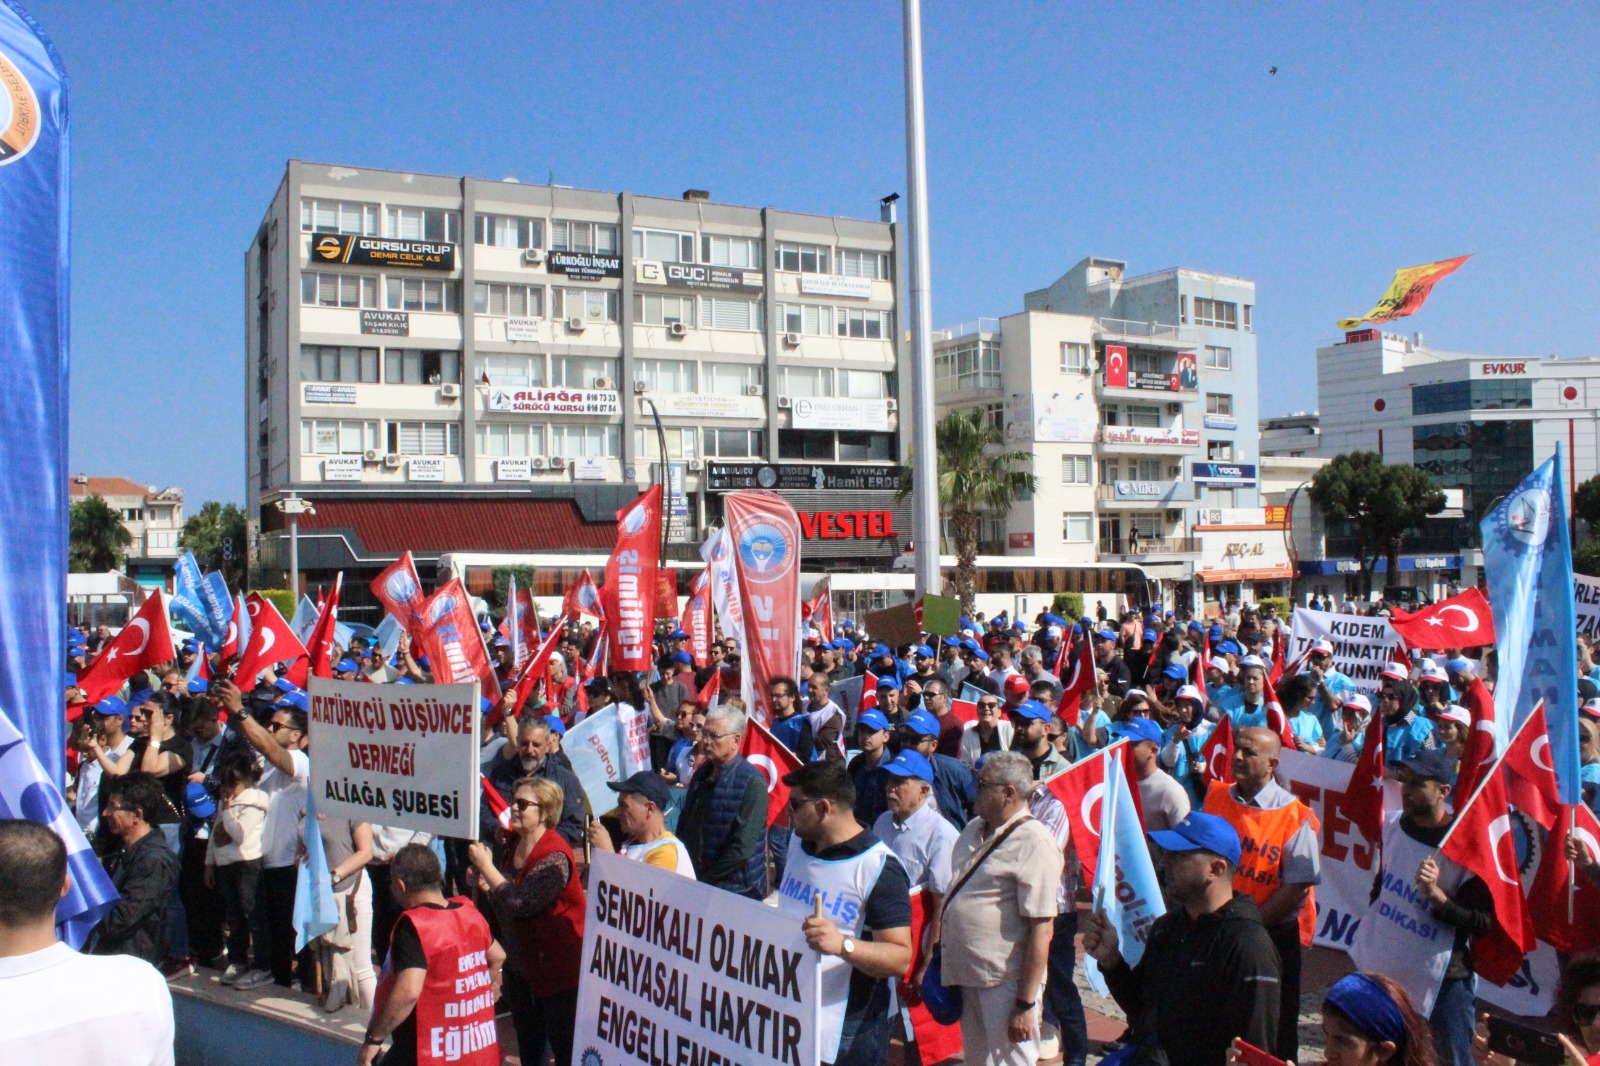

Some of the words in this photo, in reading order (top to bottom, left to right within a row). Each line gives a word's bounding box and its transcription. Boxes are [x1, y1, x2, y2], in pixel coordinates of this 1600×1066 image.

[360, 240, 410, 253] GÜRSU
[411, 243, 451, 255] GRUP
[363, 312, 407, 322] AVUKAT
[1482, 362, 1526, 375] EVKUR
[514, 389, 583, 403] ALİAĞA
[586, 393, 598, 402] 616
[599, 393, 608, 402] 73
[513, 402, 551, 411] SÜRÜCÜ
[553, 404, 585, 412] KURSU
[712, 466, 753, 475] ARABULUCU
[779, 467, 810, 475] ERDEM
[850, 468, 889, 476] AVUKAT
[827, 477, 865, 488] Hamit
[797, 511, 898, 538] VESTEL
[1330, 620, 1386, 639] KIDEM
[312, 692, 387, 735] ATATÜRKÇÜ
[389, 697, 473, 738] DÜŞÜNCE
[348, 741, 416, 777] DERNEĞİ
[325, 776, 387, 810] ALİAĞA
[392, 788, 460, 820] ŞUBESİ
[595, 879, 704, 965] SENDİKALI
[709, 923, 803, 1003] OLMAK
[589, 934, 692, 1023] ANAYASAL
[700, 981, 802, 1066] HAKTIR
[430, 1019, 497, 1062] Eğitim
